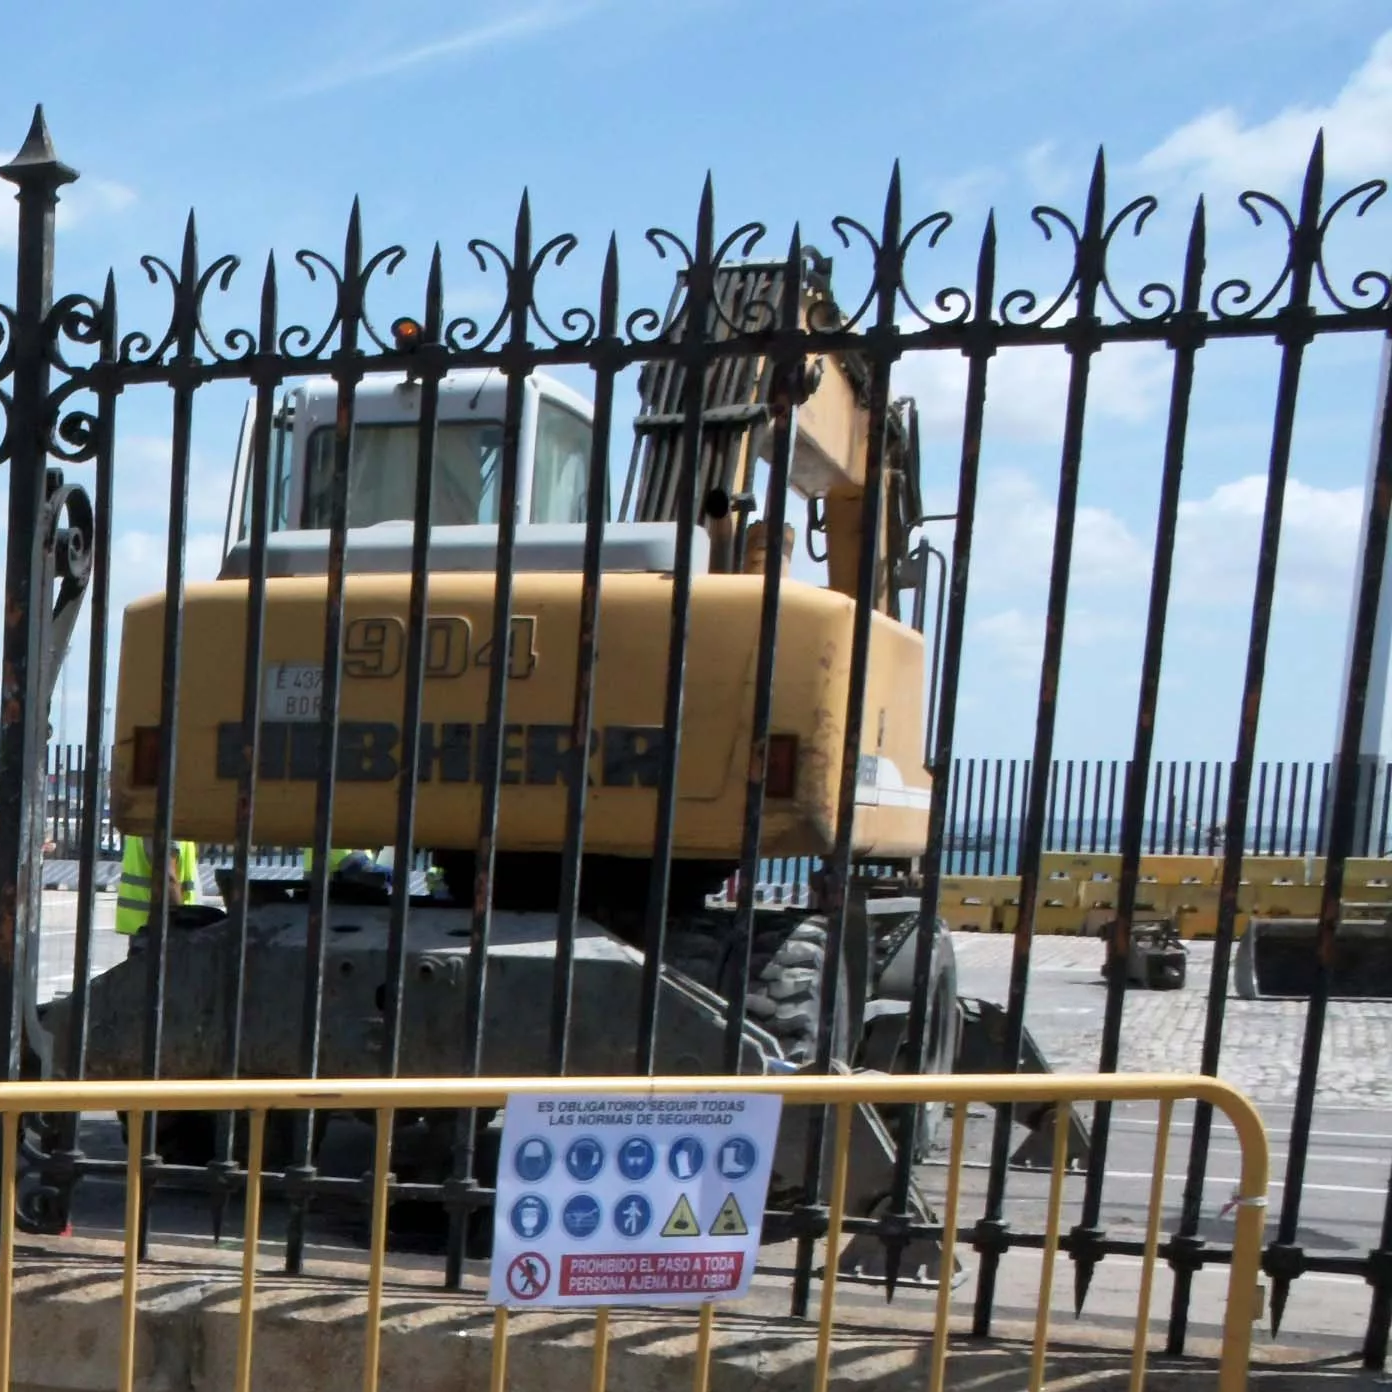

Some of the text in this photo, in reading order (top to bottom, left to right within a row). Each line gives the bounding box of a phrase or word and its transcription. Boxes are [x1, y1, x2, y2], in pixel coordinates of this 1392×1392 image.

[343, 614, 539, 679] 904
[538, 1100, 745, 1113] ES OBLIGATORIO SEGUIR TODAS
[549, 1113, 733, 1126] LAS NORMAS DE SEGURIDAD
[570, 1256, 735, 1274] PROHIBIDO EL PASO A TODA
[569, 1273, 732, 1291] PERSONA AJENA A LA OBRA
